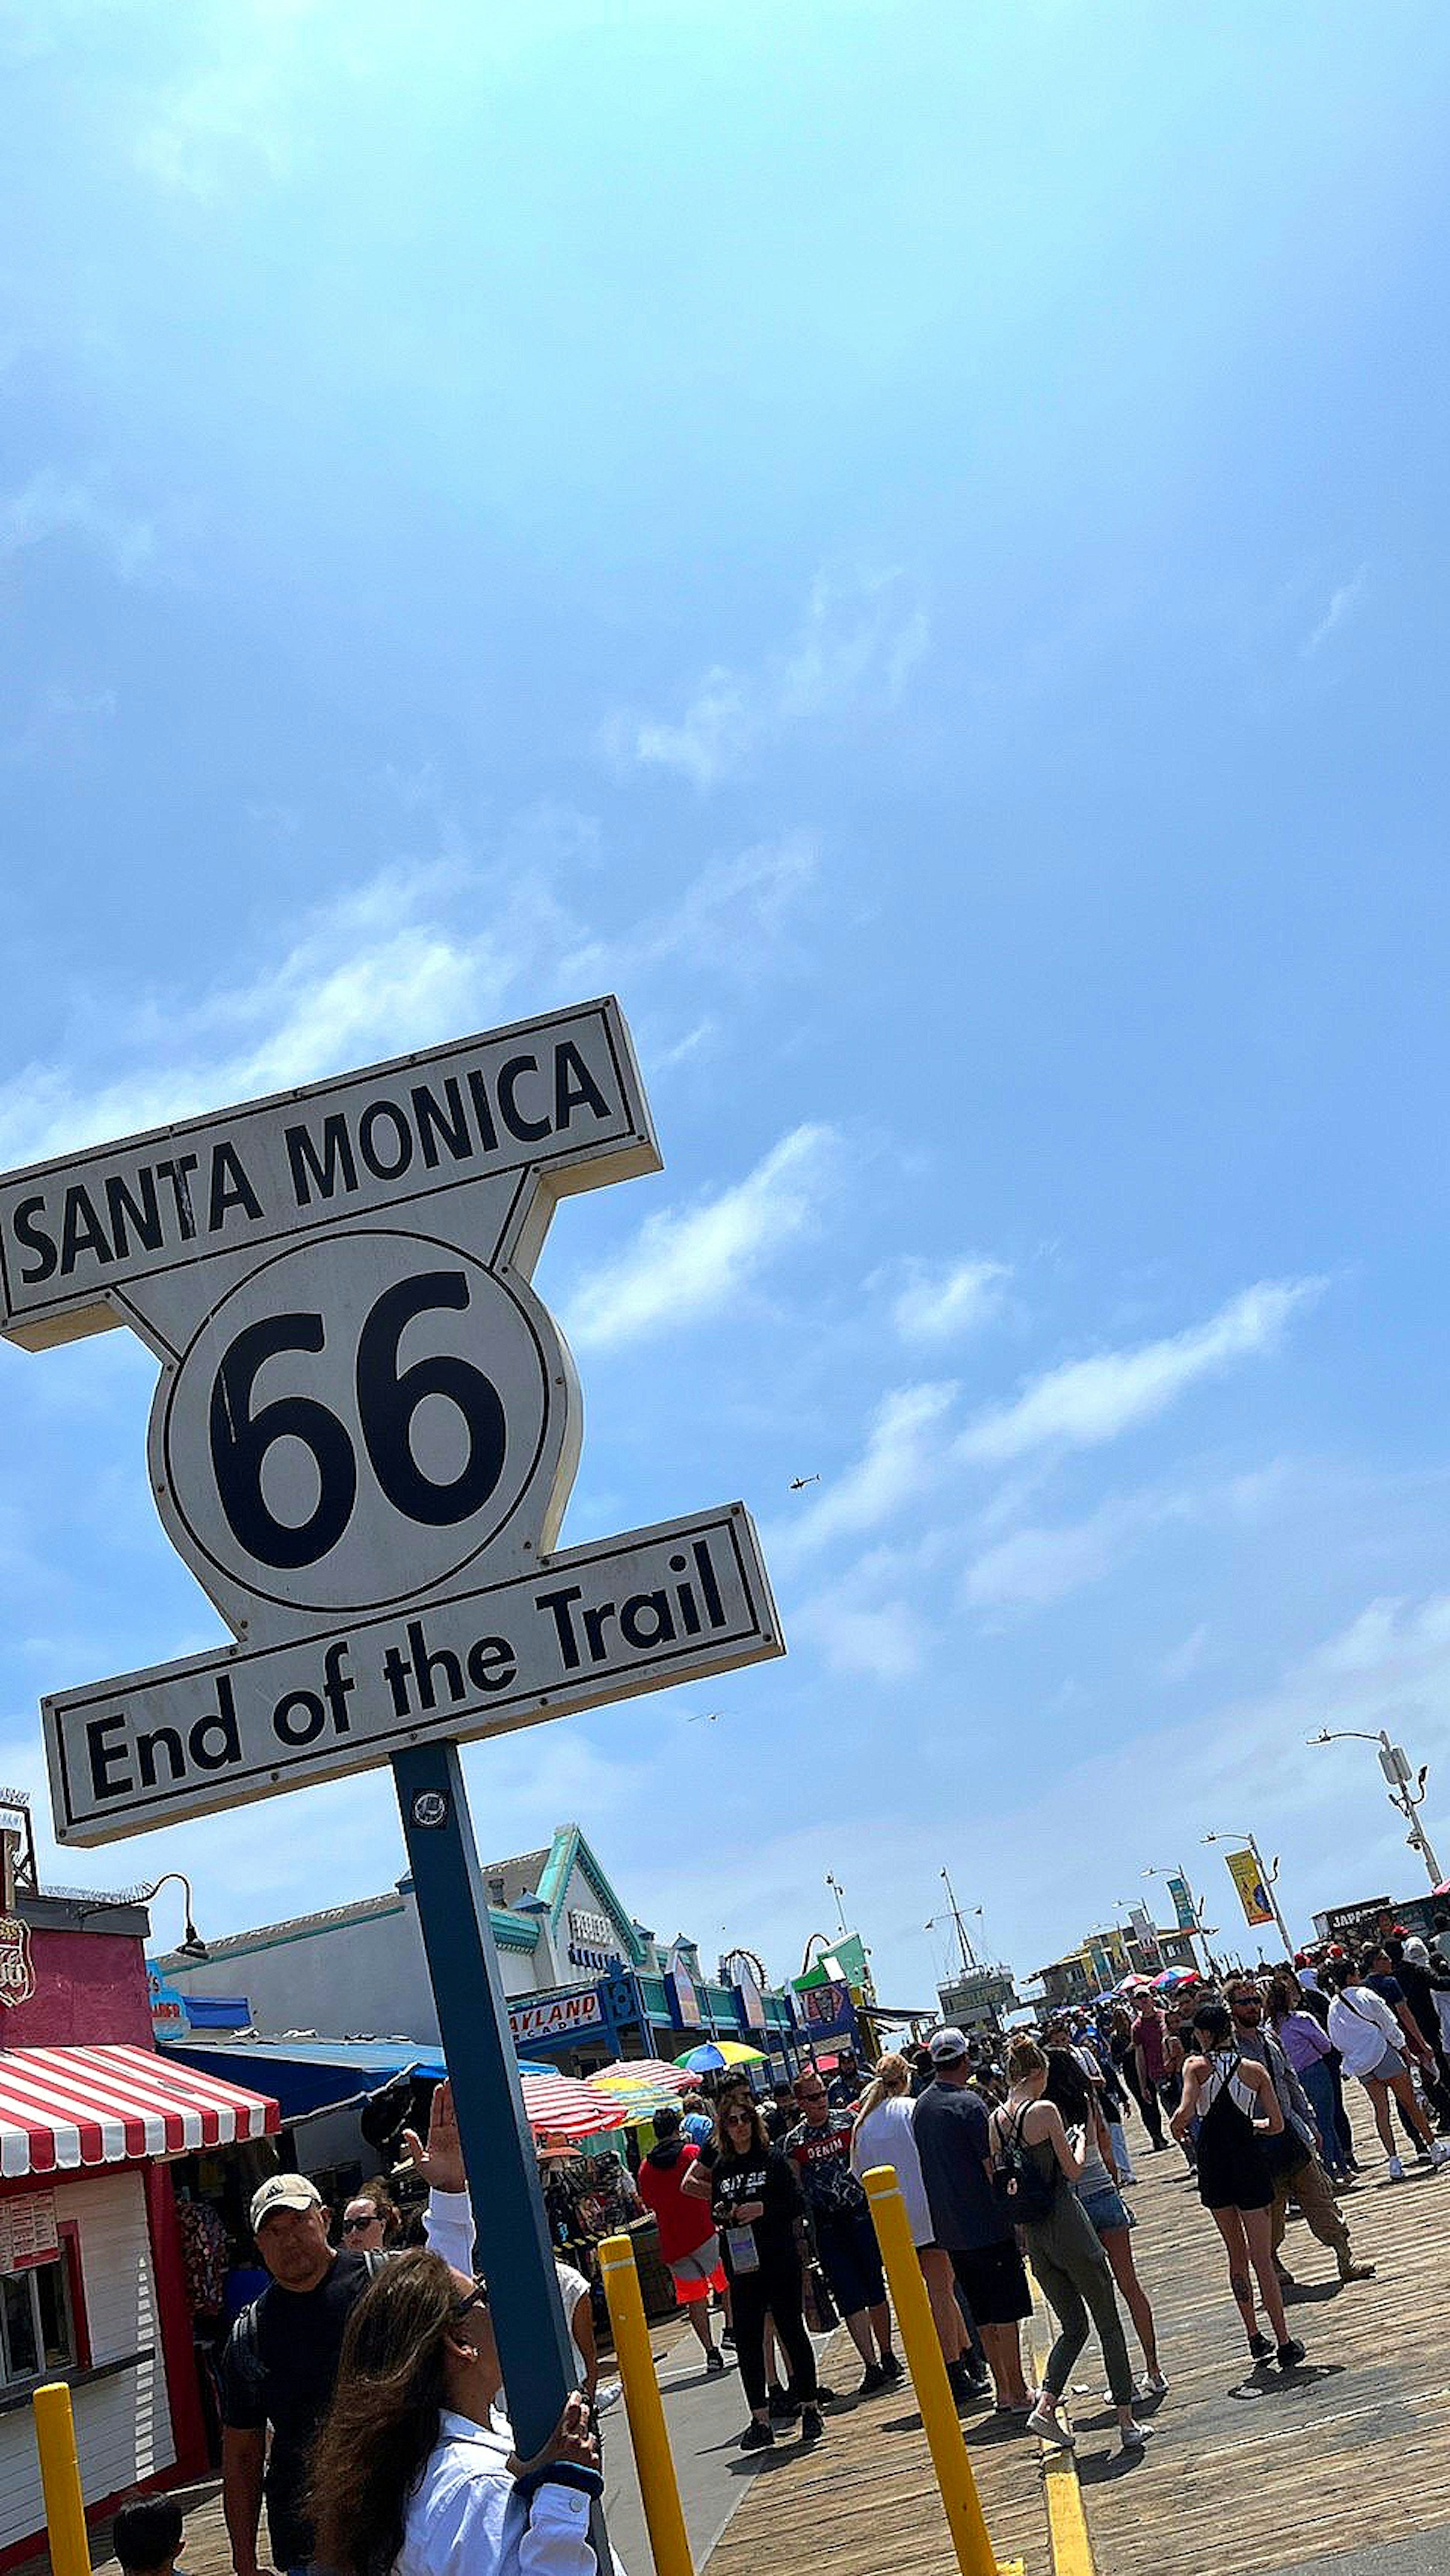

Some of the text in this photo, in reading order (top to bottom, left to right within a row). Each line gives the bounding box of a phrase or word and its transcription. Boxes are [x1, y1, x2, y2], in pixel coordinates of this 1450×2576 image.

[13, 1040, 612, 1284] SANTA MONICA
[209, 1271, 506, 1570] 66
[86, 1539, 727, 1801] End of the Trail
[807, 2137, 844, 2159] DENIM
